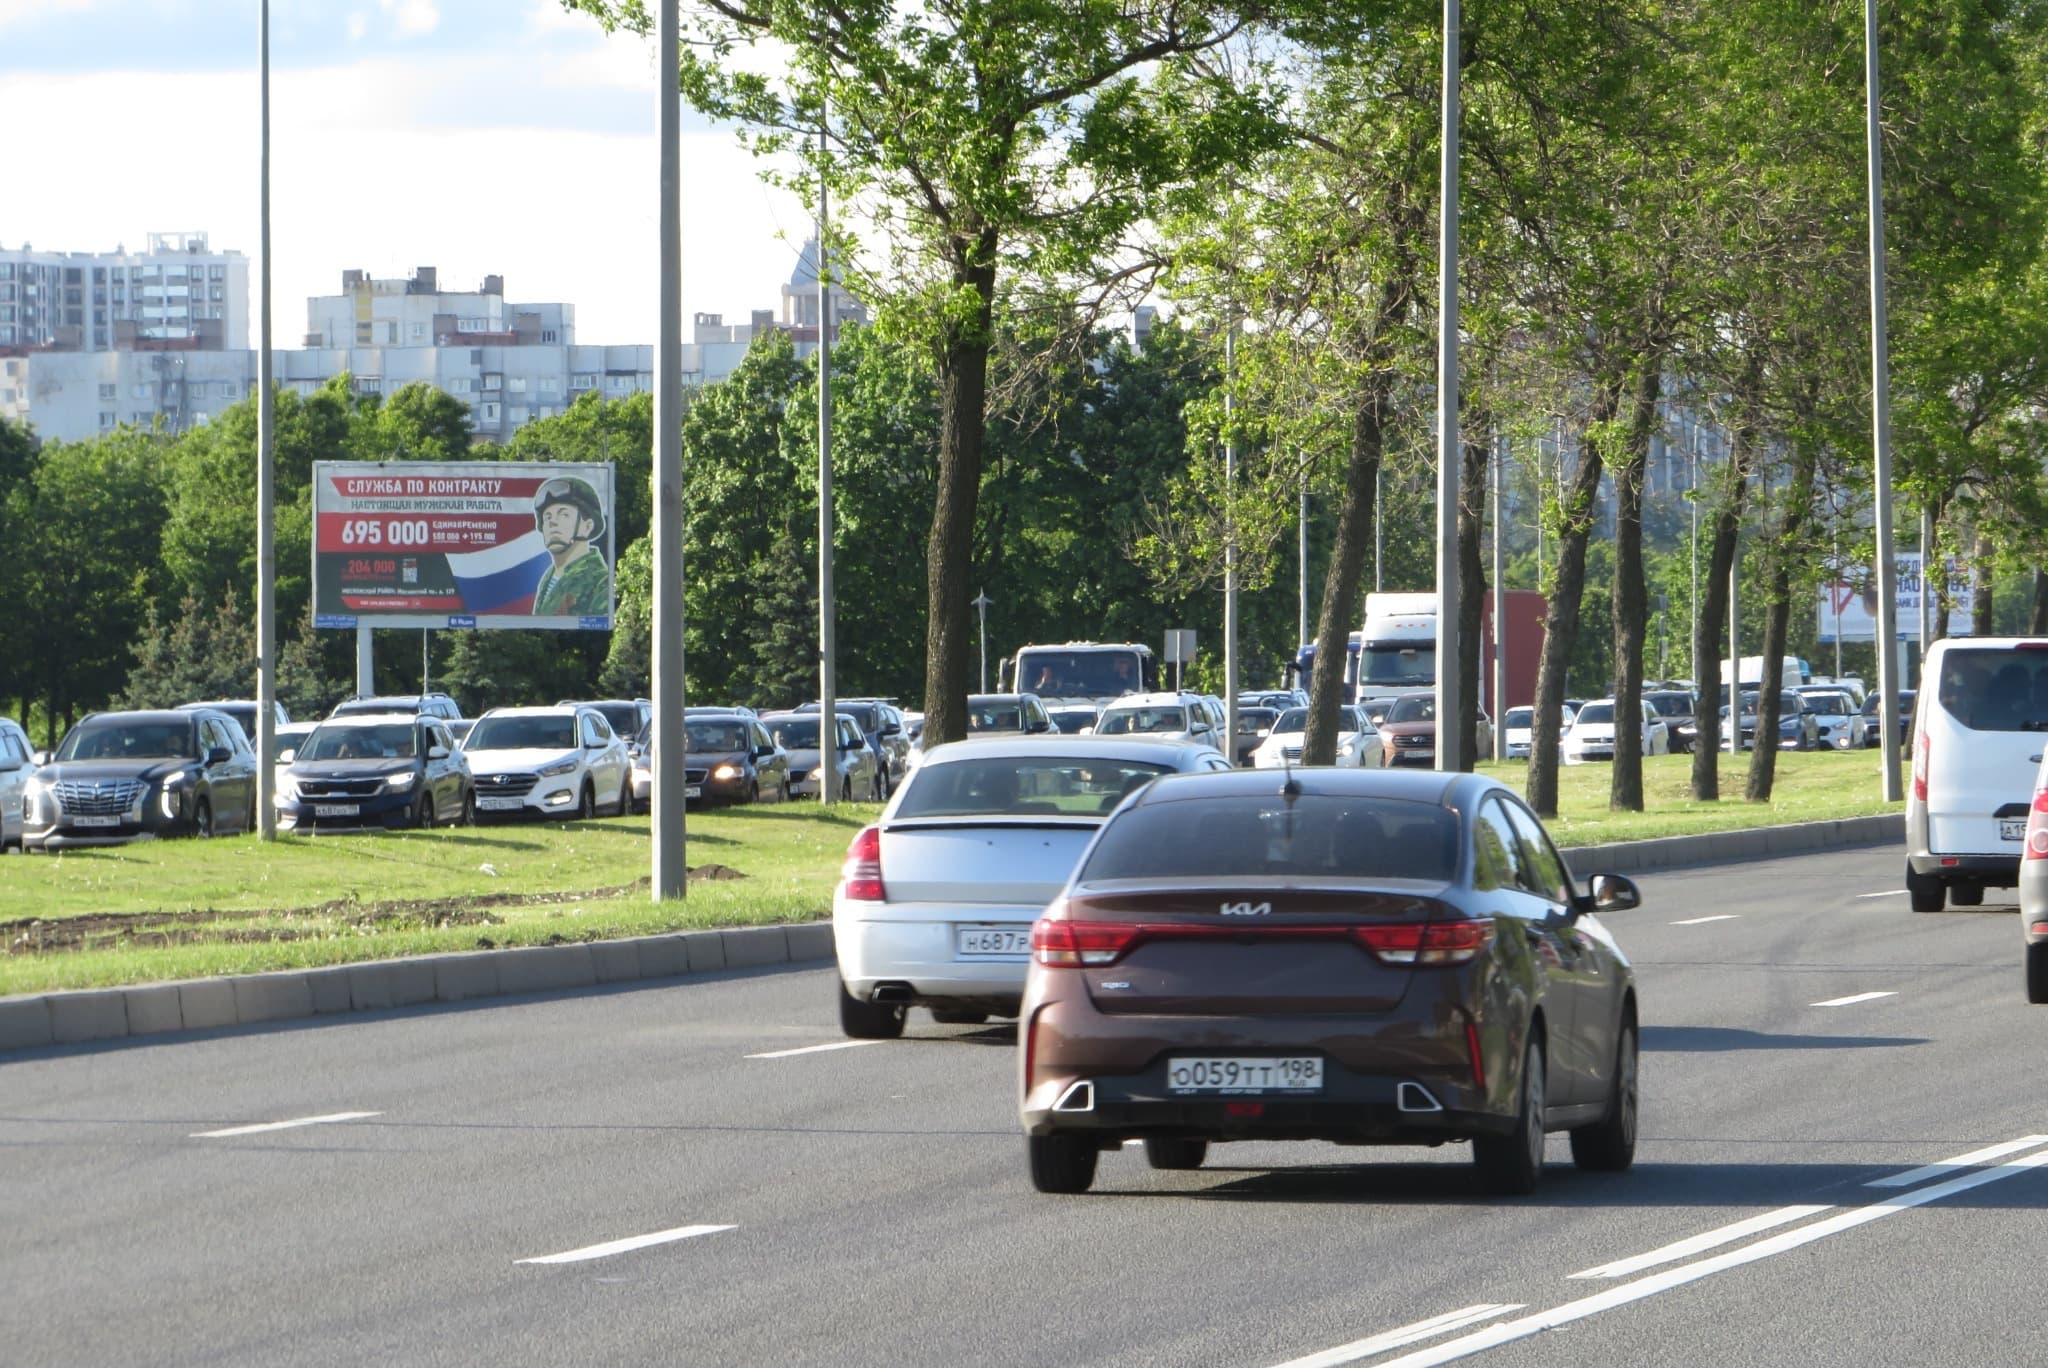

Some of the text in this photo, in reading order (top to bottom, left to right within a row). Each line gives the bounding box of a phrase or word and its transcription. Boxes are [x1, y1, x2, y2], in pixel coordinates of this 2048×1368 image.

[347, 480, 502, 494] СЛУЖБА ПО КОНТРАКТУ
[351, 500, 502, 511] НАСТОЯЩАЯ МУЖСКАЯ РАБОТА
[341, 520, 429, 544] 695 000
[1219, 902, 1272, 914] KIA
[967, 932, 1029, 951] Н687Р
[1174, 1059, 1316, 1086] О059ТТ 198
